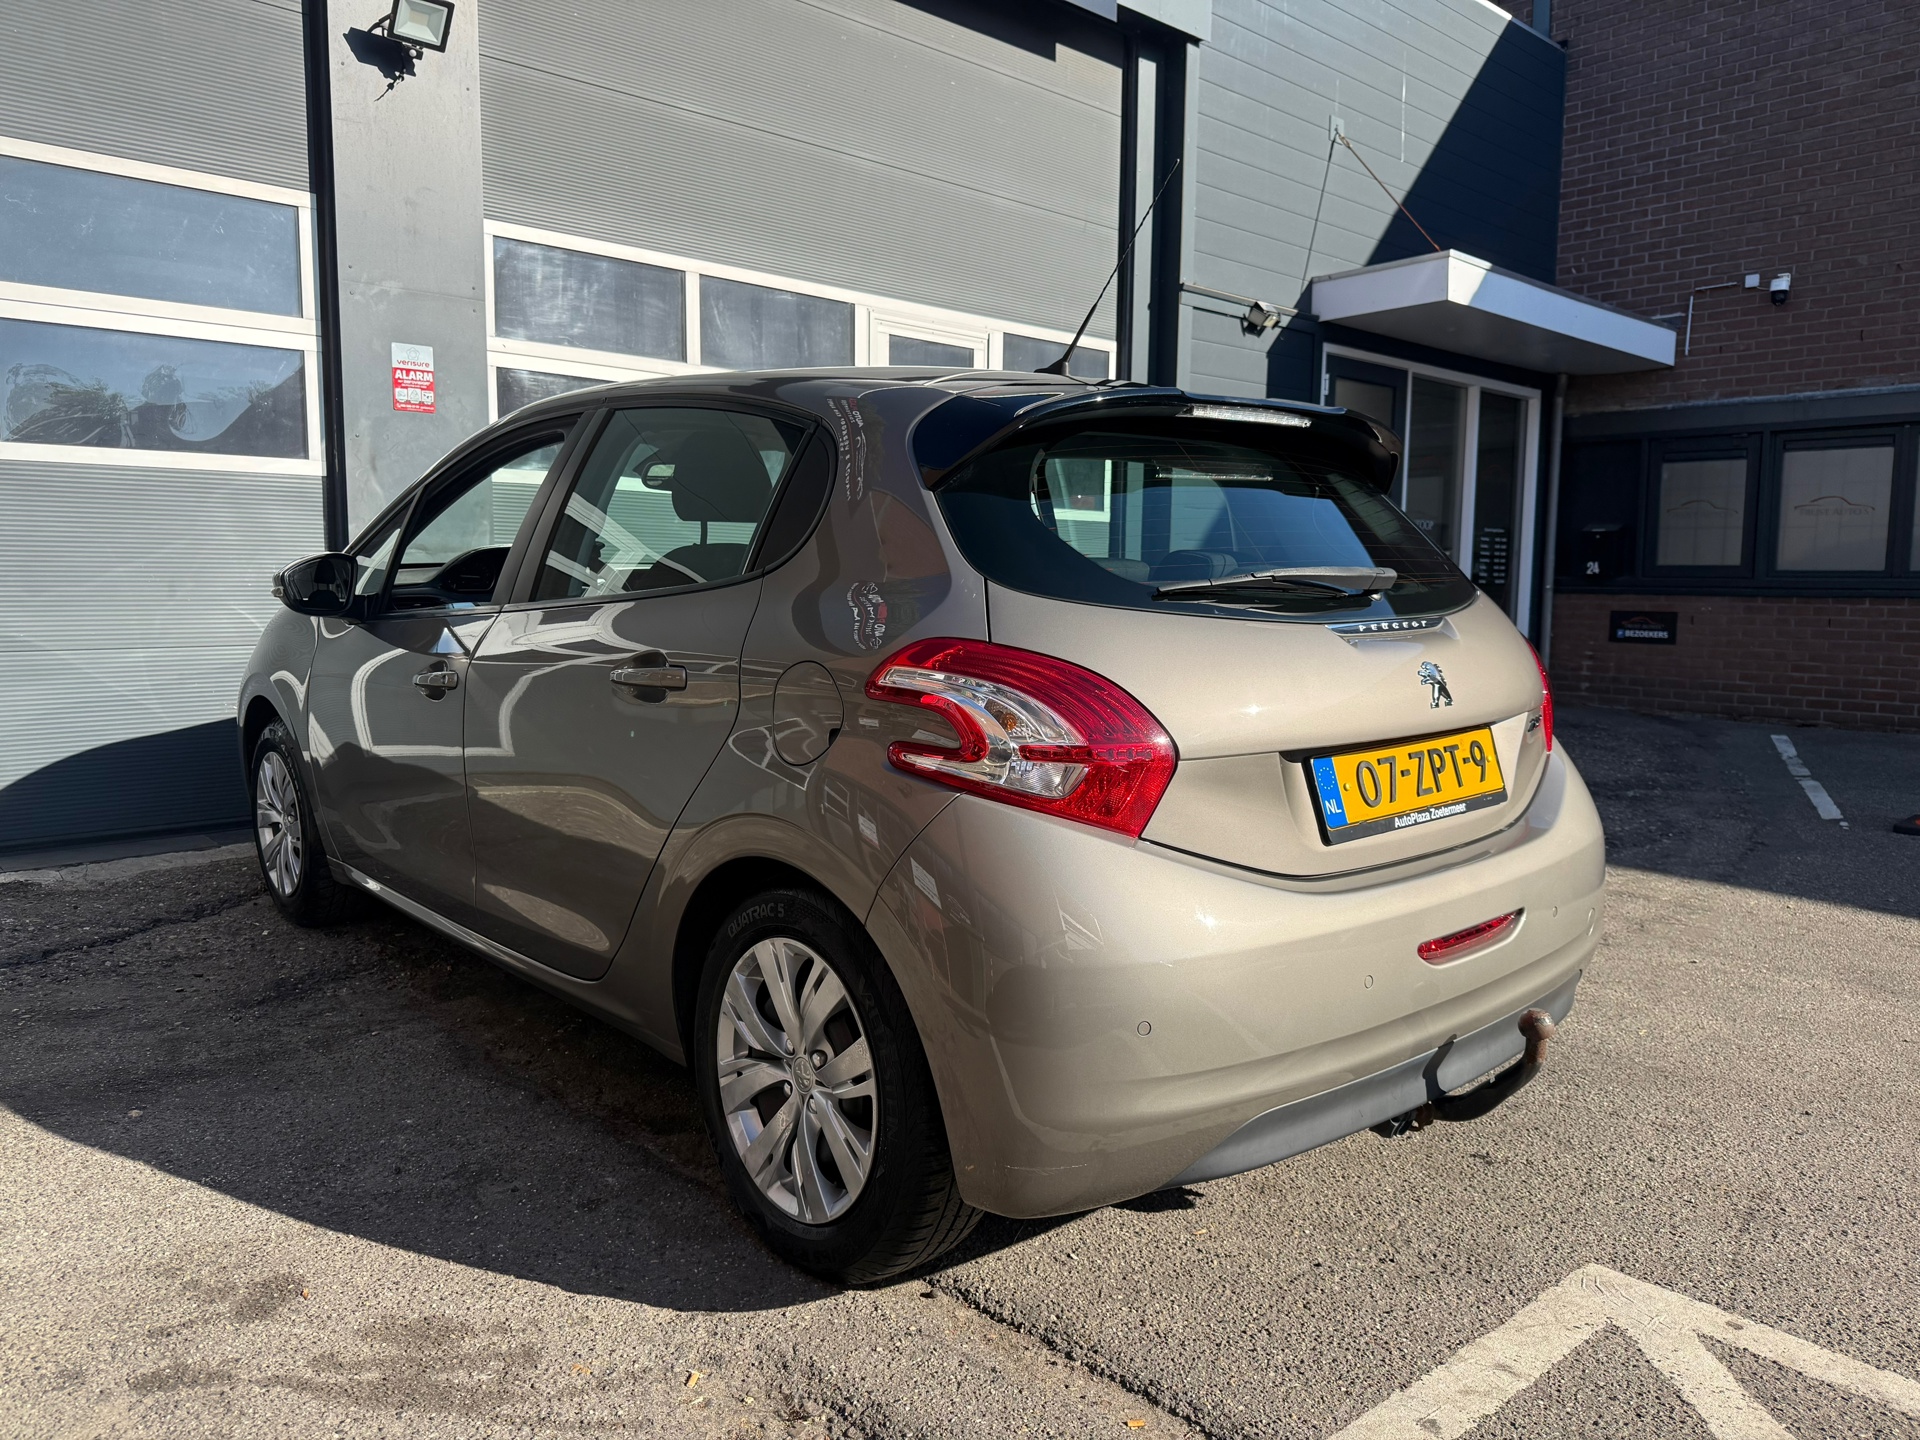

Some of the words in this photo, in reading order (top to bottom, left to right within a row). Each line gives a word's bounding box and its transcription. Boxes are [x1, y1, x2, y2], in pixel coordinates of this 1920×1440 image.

[397, 360, 429, 368] verisure
[395, 370, 433, 382] ALARM
[1586, 561, 1600, 574] 24
[1359, 620, 1427, 632] PEUGEOT
[1625, 630, 1668, 638] BEZOEKERS
[1324, 800, 1342, 815] NL
[1356, 740, 1486, 808] 07-ZPT-9
[1394, 811, 1430, 828] AutoPlaza
[1429, 802, 1467, 820] Zoetermeer
[727, 903, 774, 938] QUATRAC
[777, 902, 785, 918] 5
